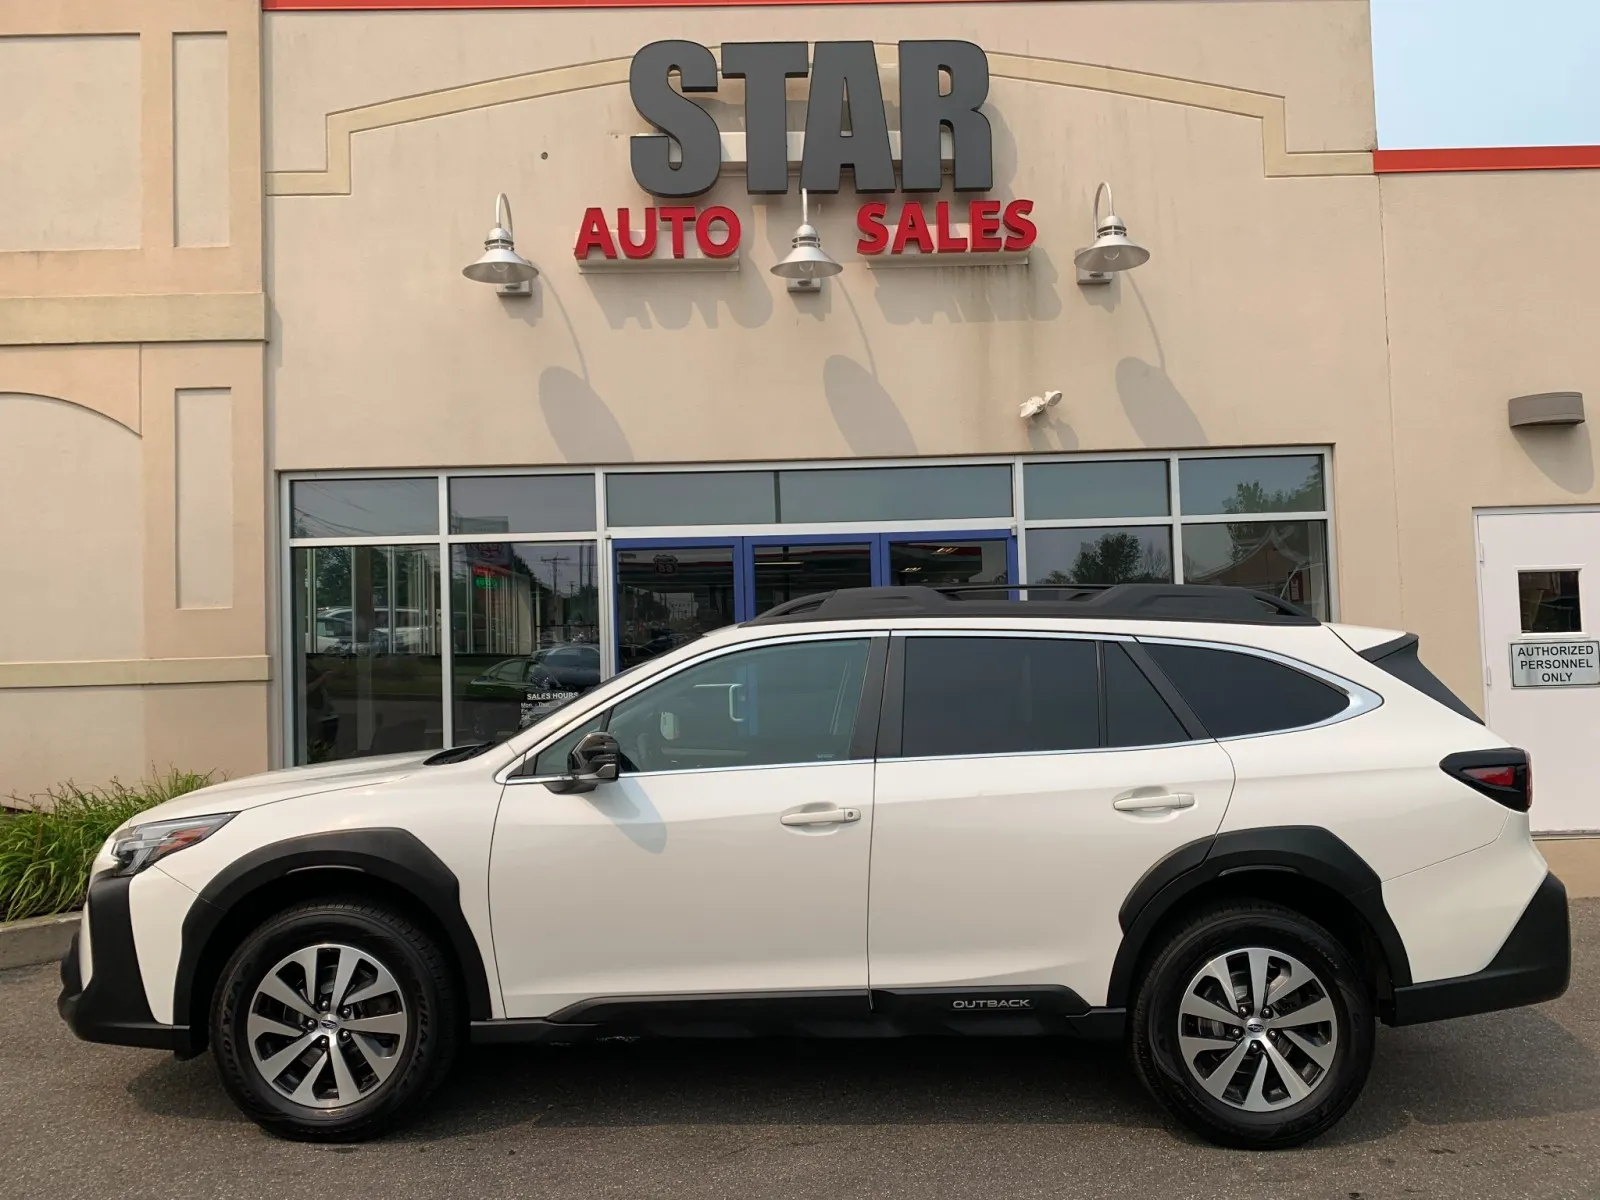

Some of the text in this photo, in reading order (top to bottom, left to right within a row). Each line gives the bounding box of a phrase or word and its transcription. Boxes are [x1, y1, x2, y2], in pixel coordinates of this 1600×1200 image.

[630, 40, 993, 197] STAR
[574, 199, 1037, 260] AUTO SALES
[1518, 645, 1594, 657] AUTHORIZED
[1520, 659, 1593, 670] PERSONNEL
[1541, 672, 1573, 683] ONLY
[552, 691, 579, 699] HOURS
[952, 999, 1032, 1009] OUTBACK
